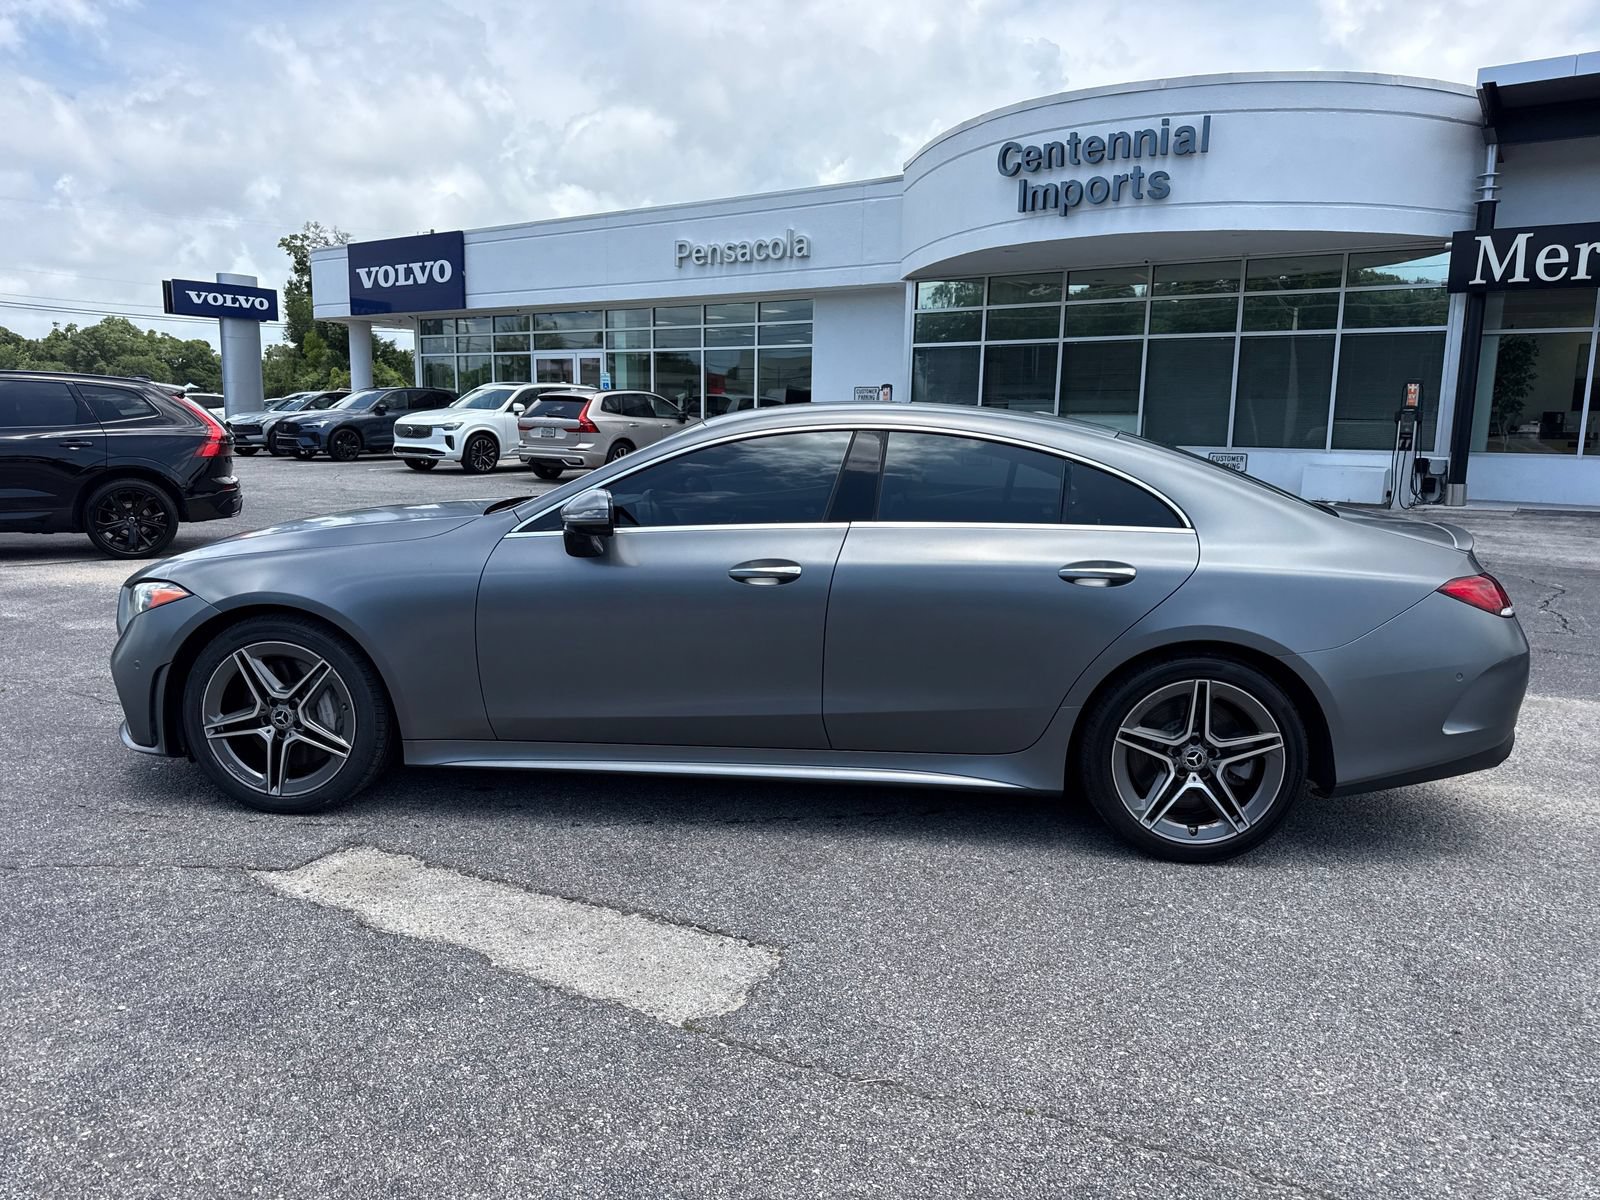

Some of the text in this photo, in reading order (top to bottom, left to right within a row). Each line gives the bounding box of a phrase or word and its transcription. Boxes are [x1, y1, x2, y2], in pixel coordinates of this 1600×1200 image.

[997, 115, 1211, 177] Centennial
[1018, 165, 1171, 217] Imports
[674, 228, 810, 268] Pensacola
[1468, 232, 1600, 285] Mer
[356, 259, 452, 289] VOLVO
[185, 290, 269, 311] VOLVO
